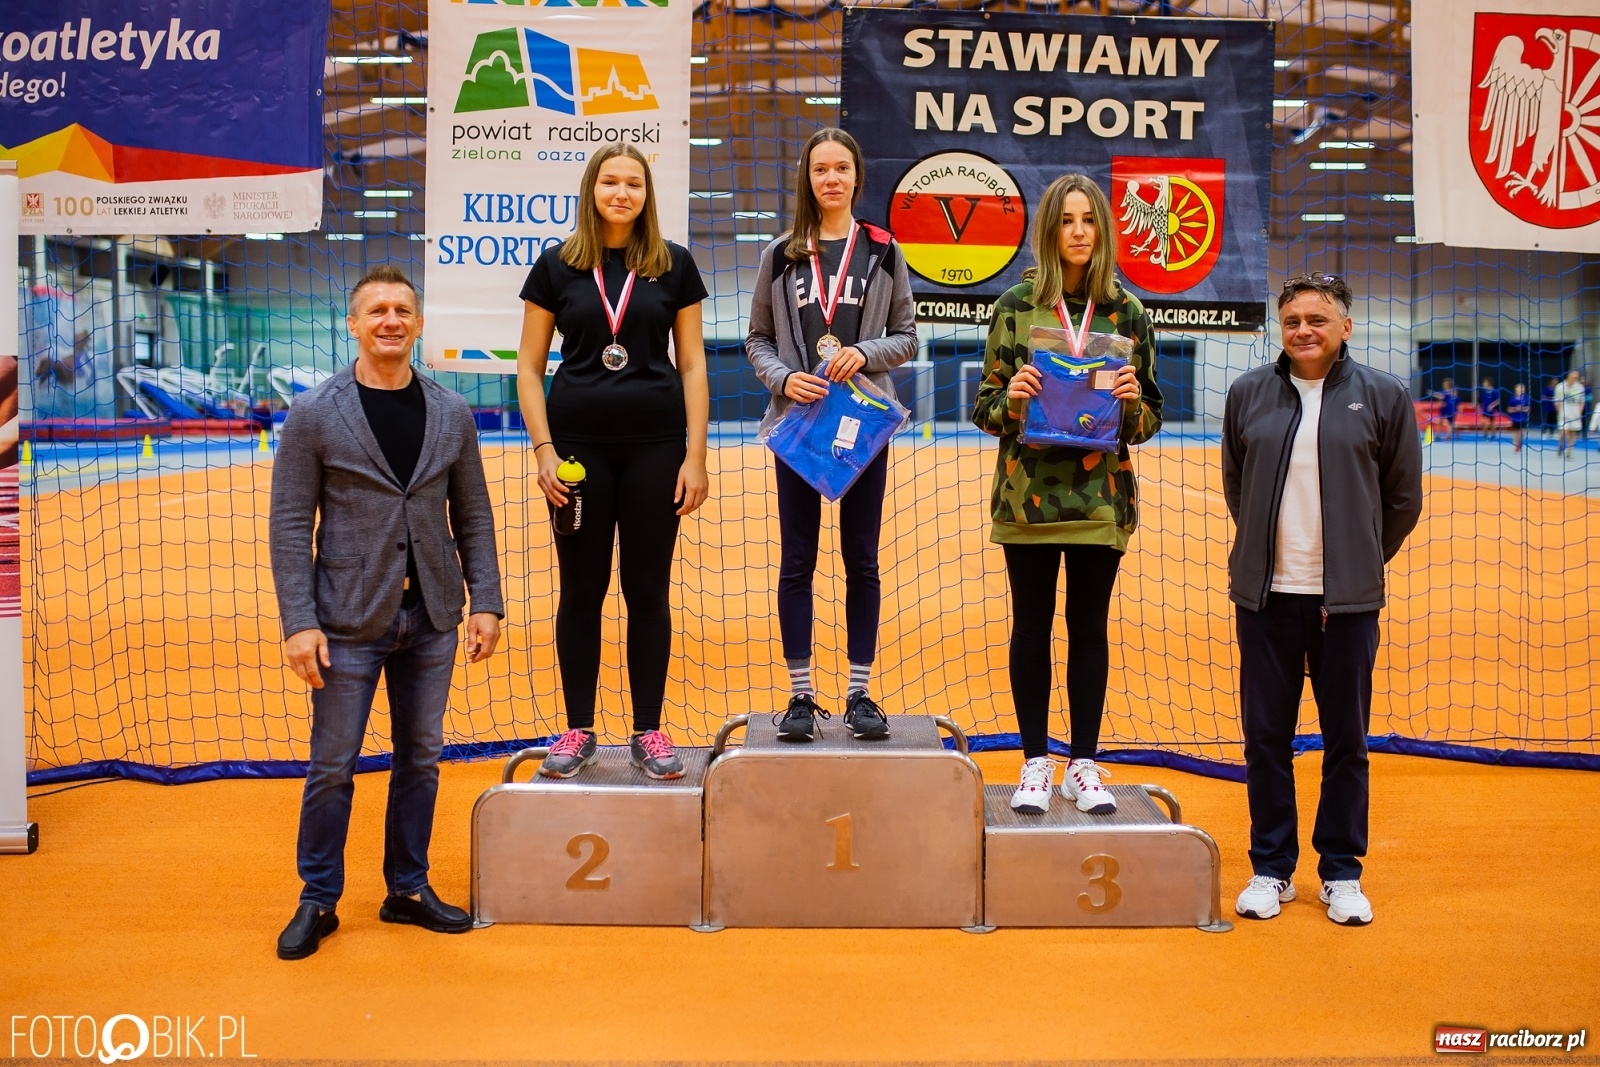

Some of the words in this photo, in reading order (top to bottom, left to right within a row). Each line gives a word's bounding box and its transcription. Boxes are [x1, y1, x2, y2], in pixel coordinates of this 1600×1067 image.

[0, 17, 221, 70] oatletyka
[902, 28, 1220, 78] STAWIAMY
[914, 91, 998, 134] NA
[1012, 95, 1205, 140] SPORT
[452, 120, 532, 145] powiat
[548, 121, 661, 143] raciborski
[451, 146, 522, 160] zielona
[537, 149, 586, 162] oaza
[96, 196, 145, 205] POLSKIEGO
[148, 195, 188, 206] ZWIĄZKU
[233, 191, 278, 201] MINISTER
[901, 166, 953, 211] VICTORIA
[957, 166, 1015, 215] RACIBÓRZ
[53, 196, 95, 216] 100
[96, 207, 111, 216] LAT
[113, 207, 147, 216] LEKKIEJ
[150, 207, 188, 216] ATLETYKI
[233, 202, 279, 210] EDUKACJI
[233, 211, 293, 220] NARODOWEJ
[934, 196, 981, 243] V
[941, 268, 973, 281] 1970
[1347, 402, 1364, 411] 4F
[825, 812, 860, 871] 1
[565, 832, 611, 892] 2
[1077, 853, 1123, 914] 3
